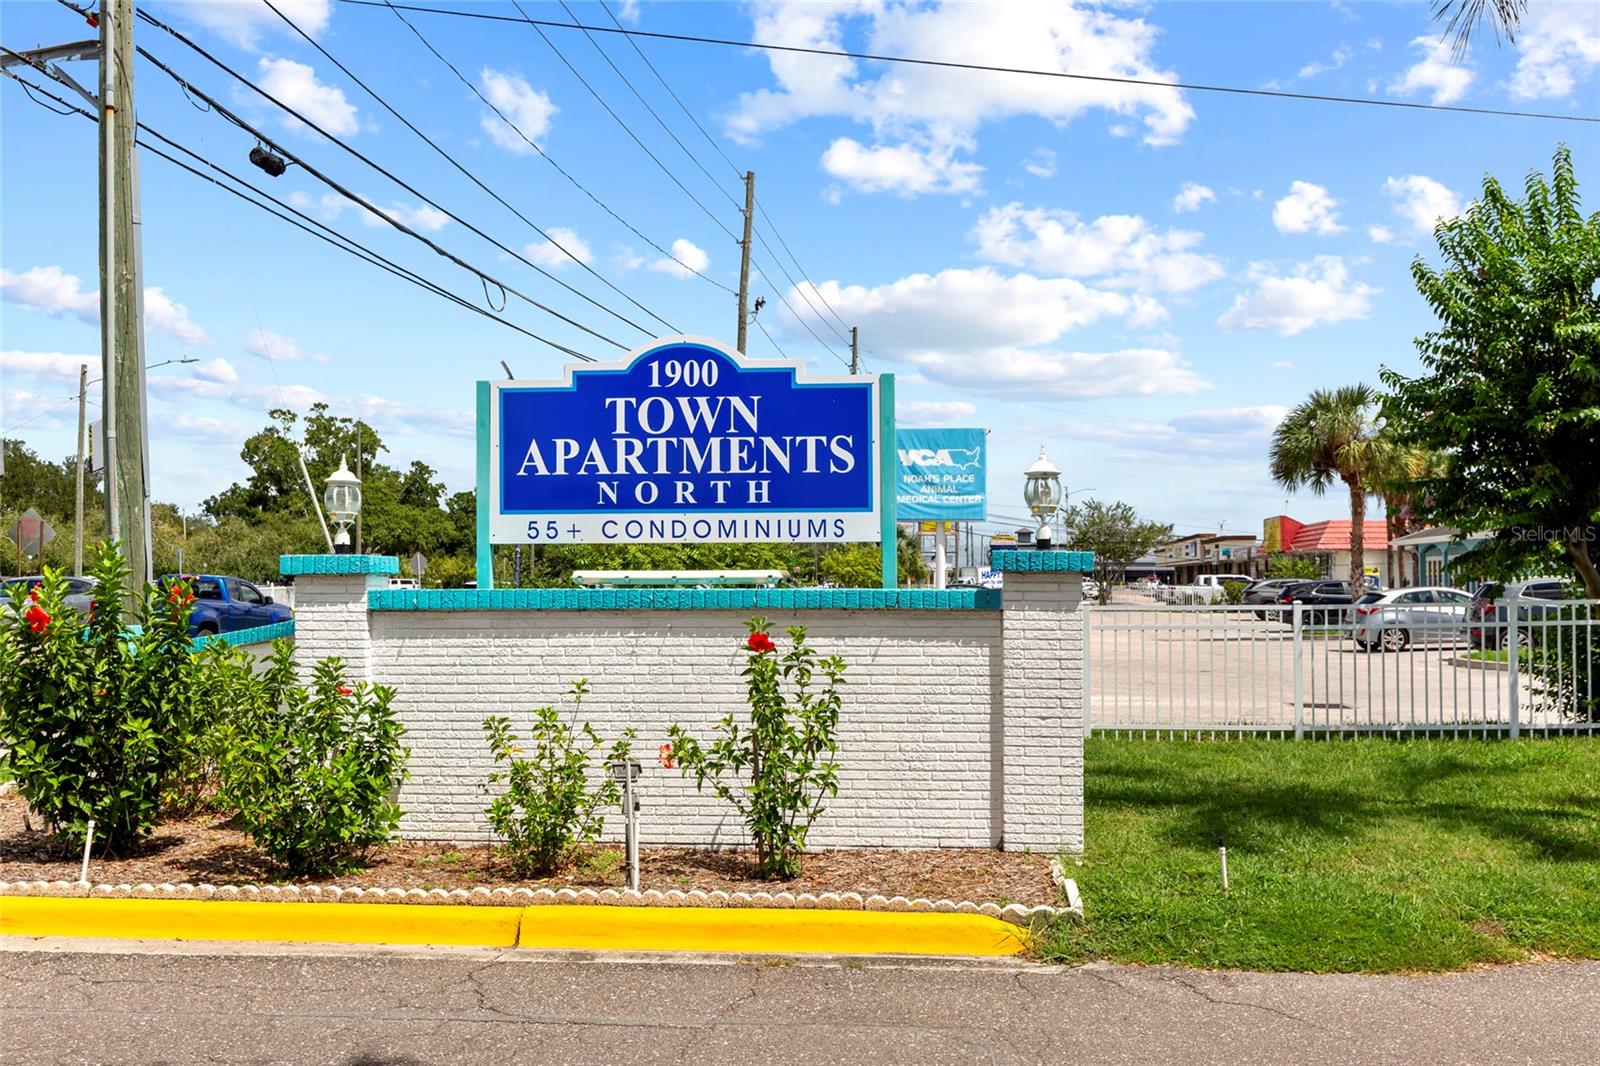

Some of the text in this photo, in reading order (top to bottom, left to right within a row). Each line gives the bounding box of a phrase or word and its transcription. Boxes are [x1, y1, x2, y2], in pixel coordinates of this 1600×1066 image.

[648, 359, 718, 388] 1900
[605, 395, 762, 435] TOWN
[516, 435, 855, 476] APARTMENTS
[897, 448, 953, 467] VCA
[903, 474, 975, 483] NOAH'S PLACE
[597, 480, 772, 505] NORTH
[896, 494, 983, 504] MEDICAL CENTER
[920, 485, 959, 494] ANIMAL
[527, 518, 845, 540] 55+ CONDOMINIUMS
[981, 571, 1000, 579] HAPPY
